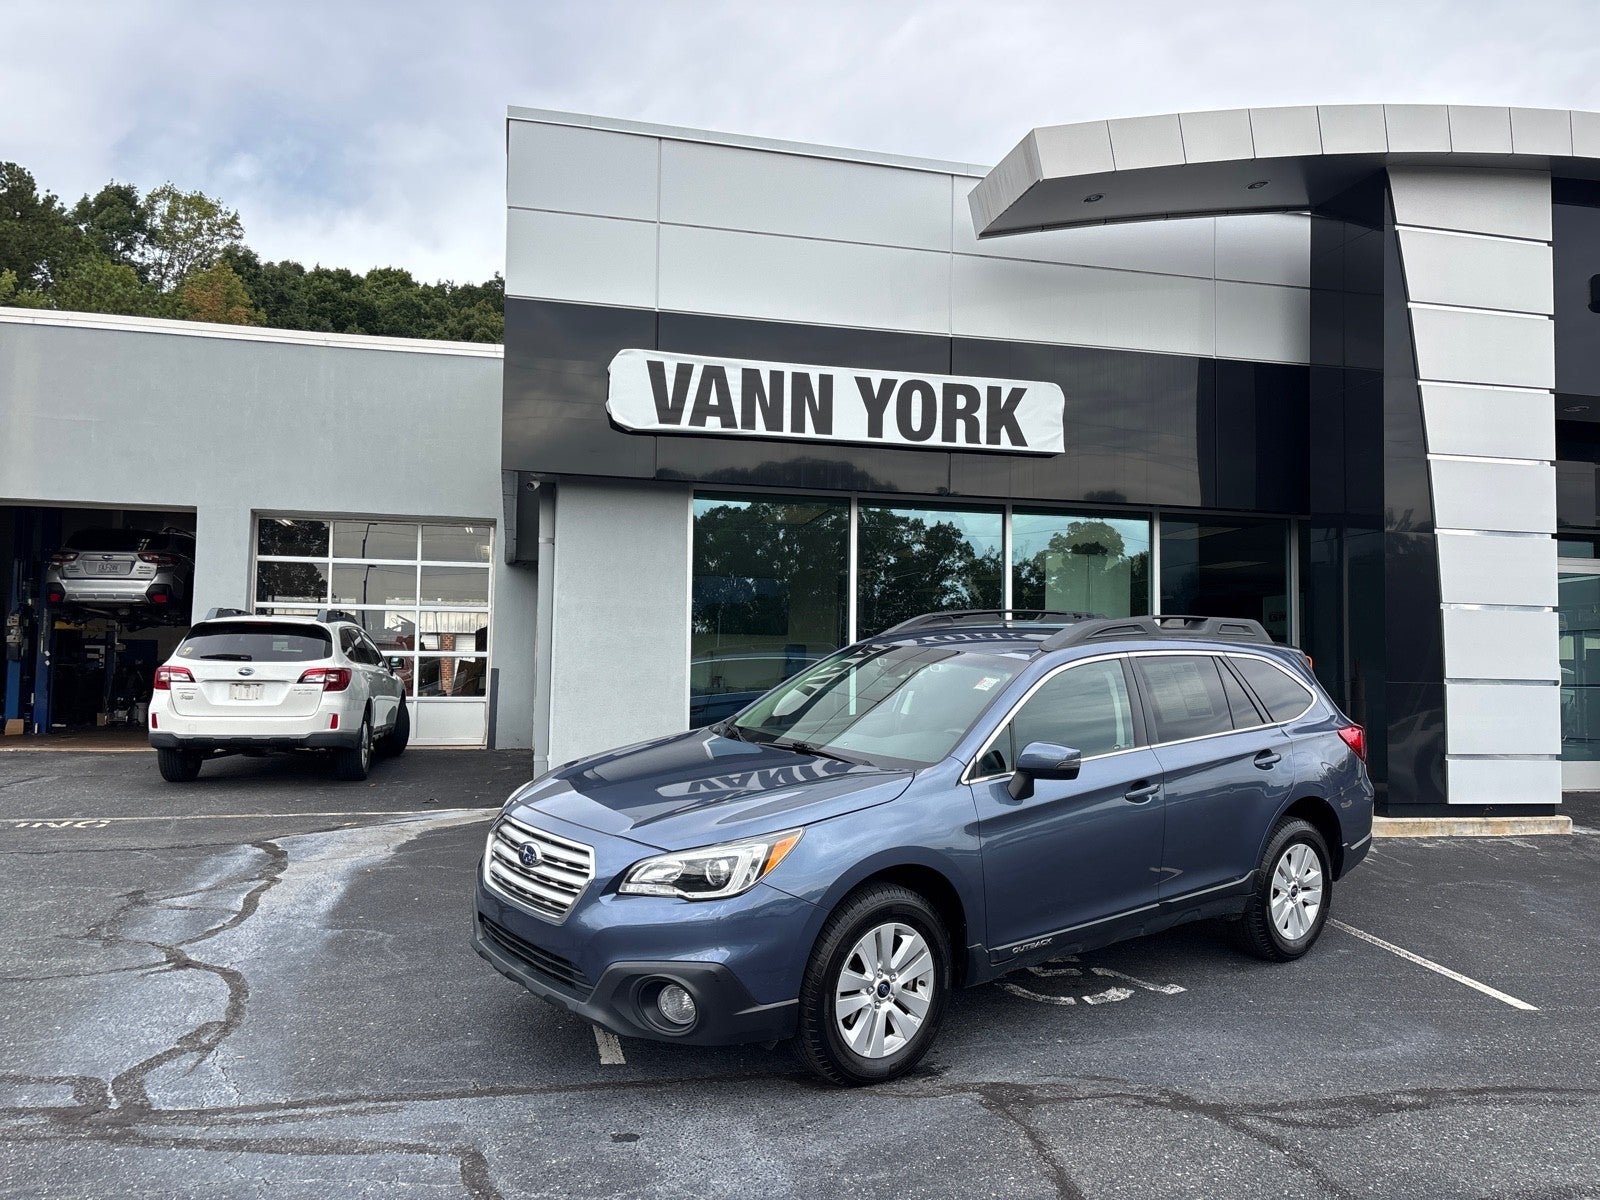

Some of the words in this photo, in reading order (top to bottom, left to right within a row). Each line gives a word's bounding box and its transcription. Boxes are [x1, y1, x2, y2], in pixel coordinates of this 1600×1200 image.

[646, 360, 834, 435] VANN
[854, 376, 1029, 447] YORK
[1012, 937, 1053, 954] OUTBACK
